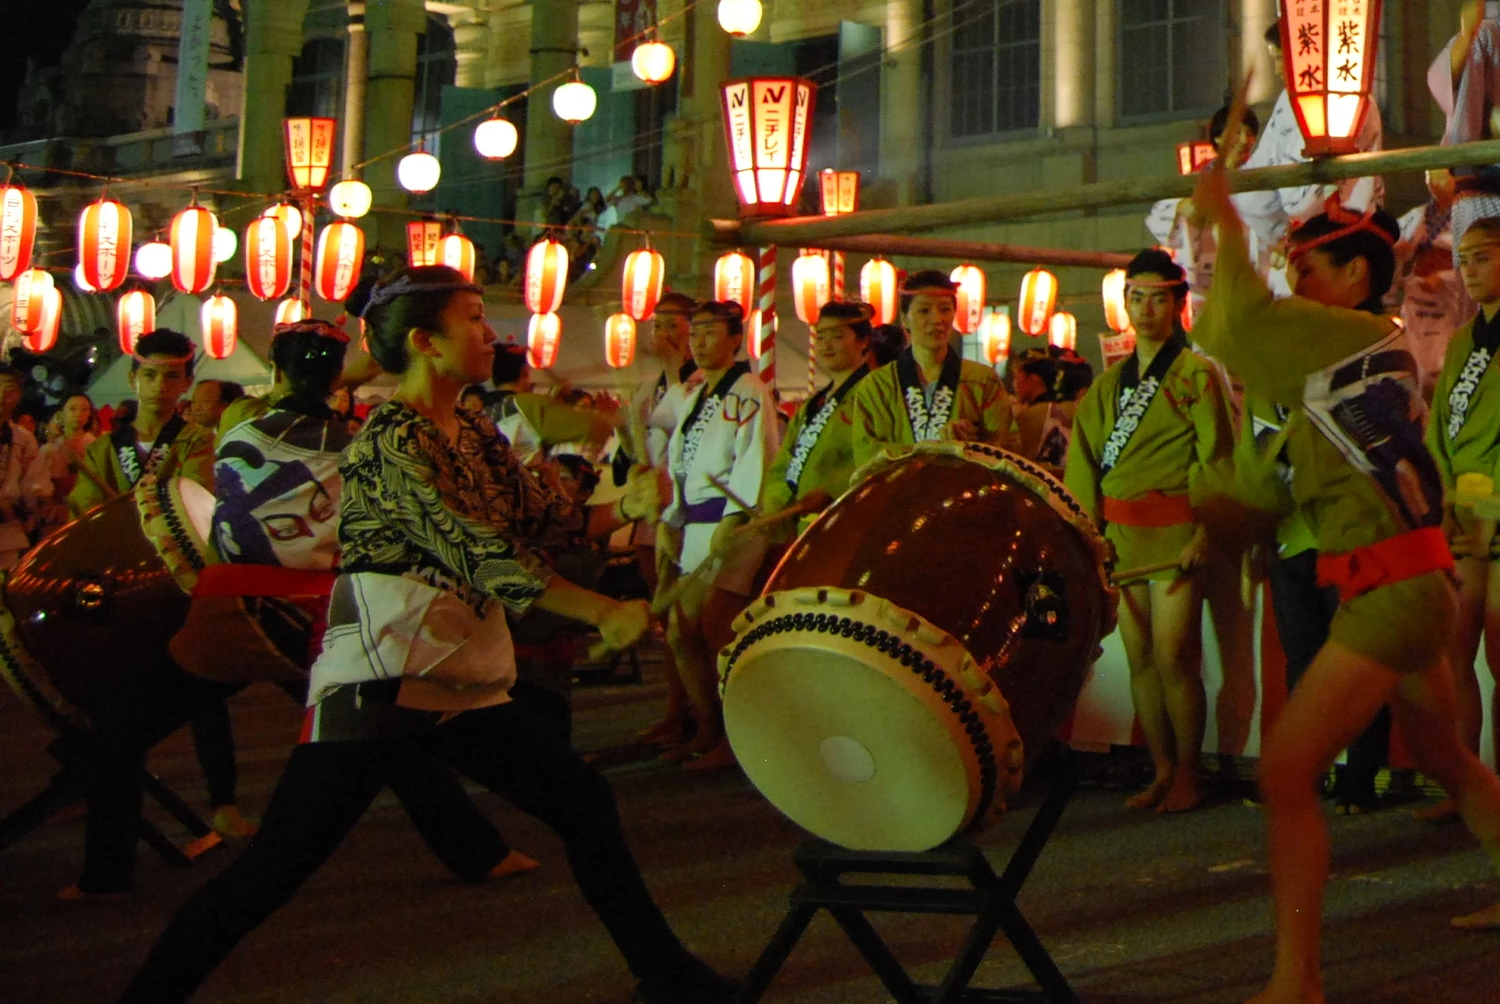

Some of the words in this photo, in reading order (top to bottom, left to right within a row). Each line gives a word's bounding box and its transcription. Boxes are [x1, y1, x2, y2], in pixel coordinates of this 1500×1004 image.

[1298, 23, 1322, 88] 紫水
[1336, 21, 1360, 82] 紫水
[765, 110, 779, 161] ニチレイ
